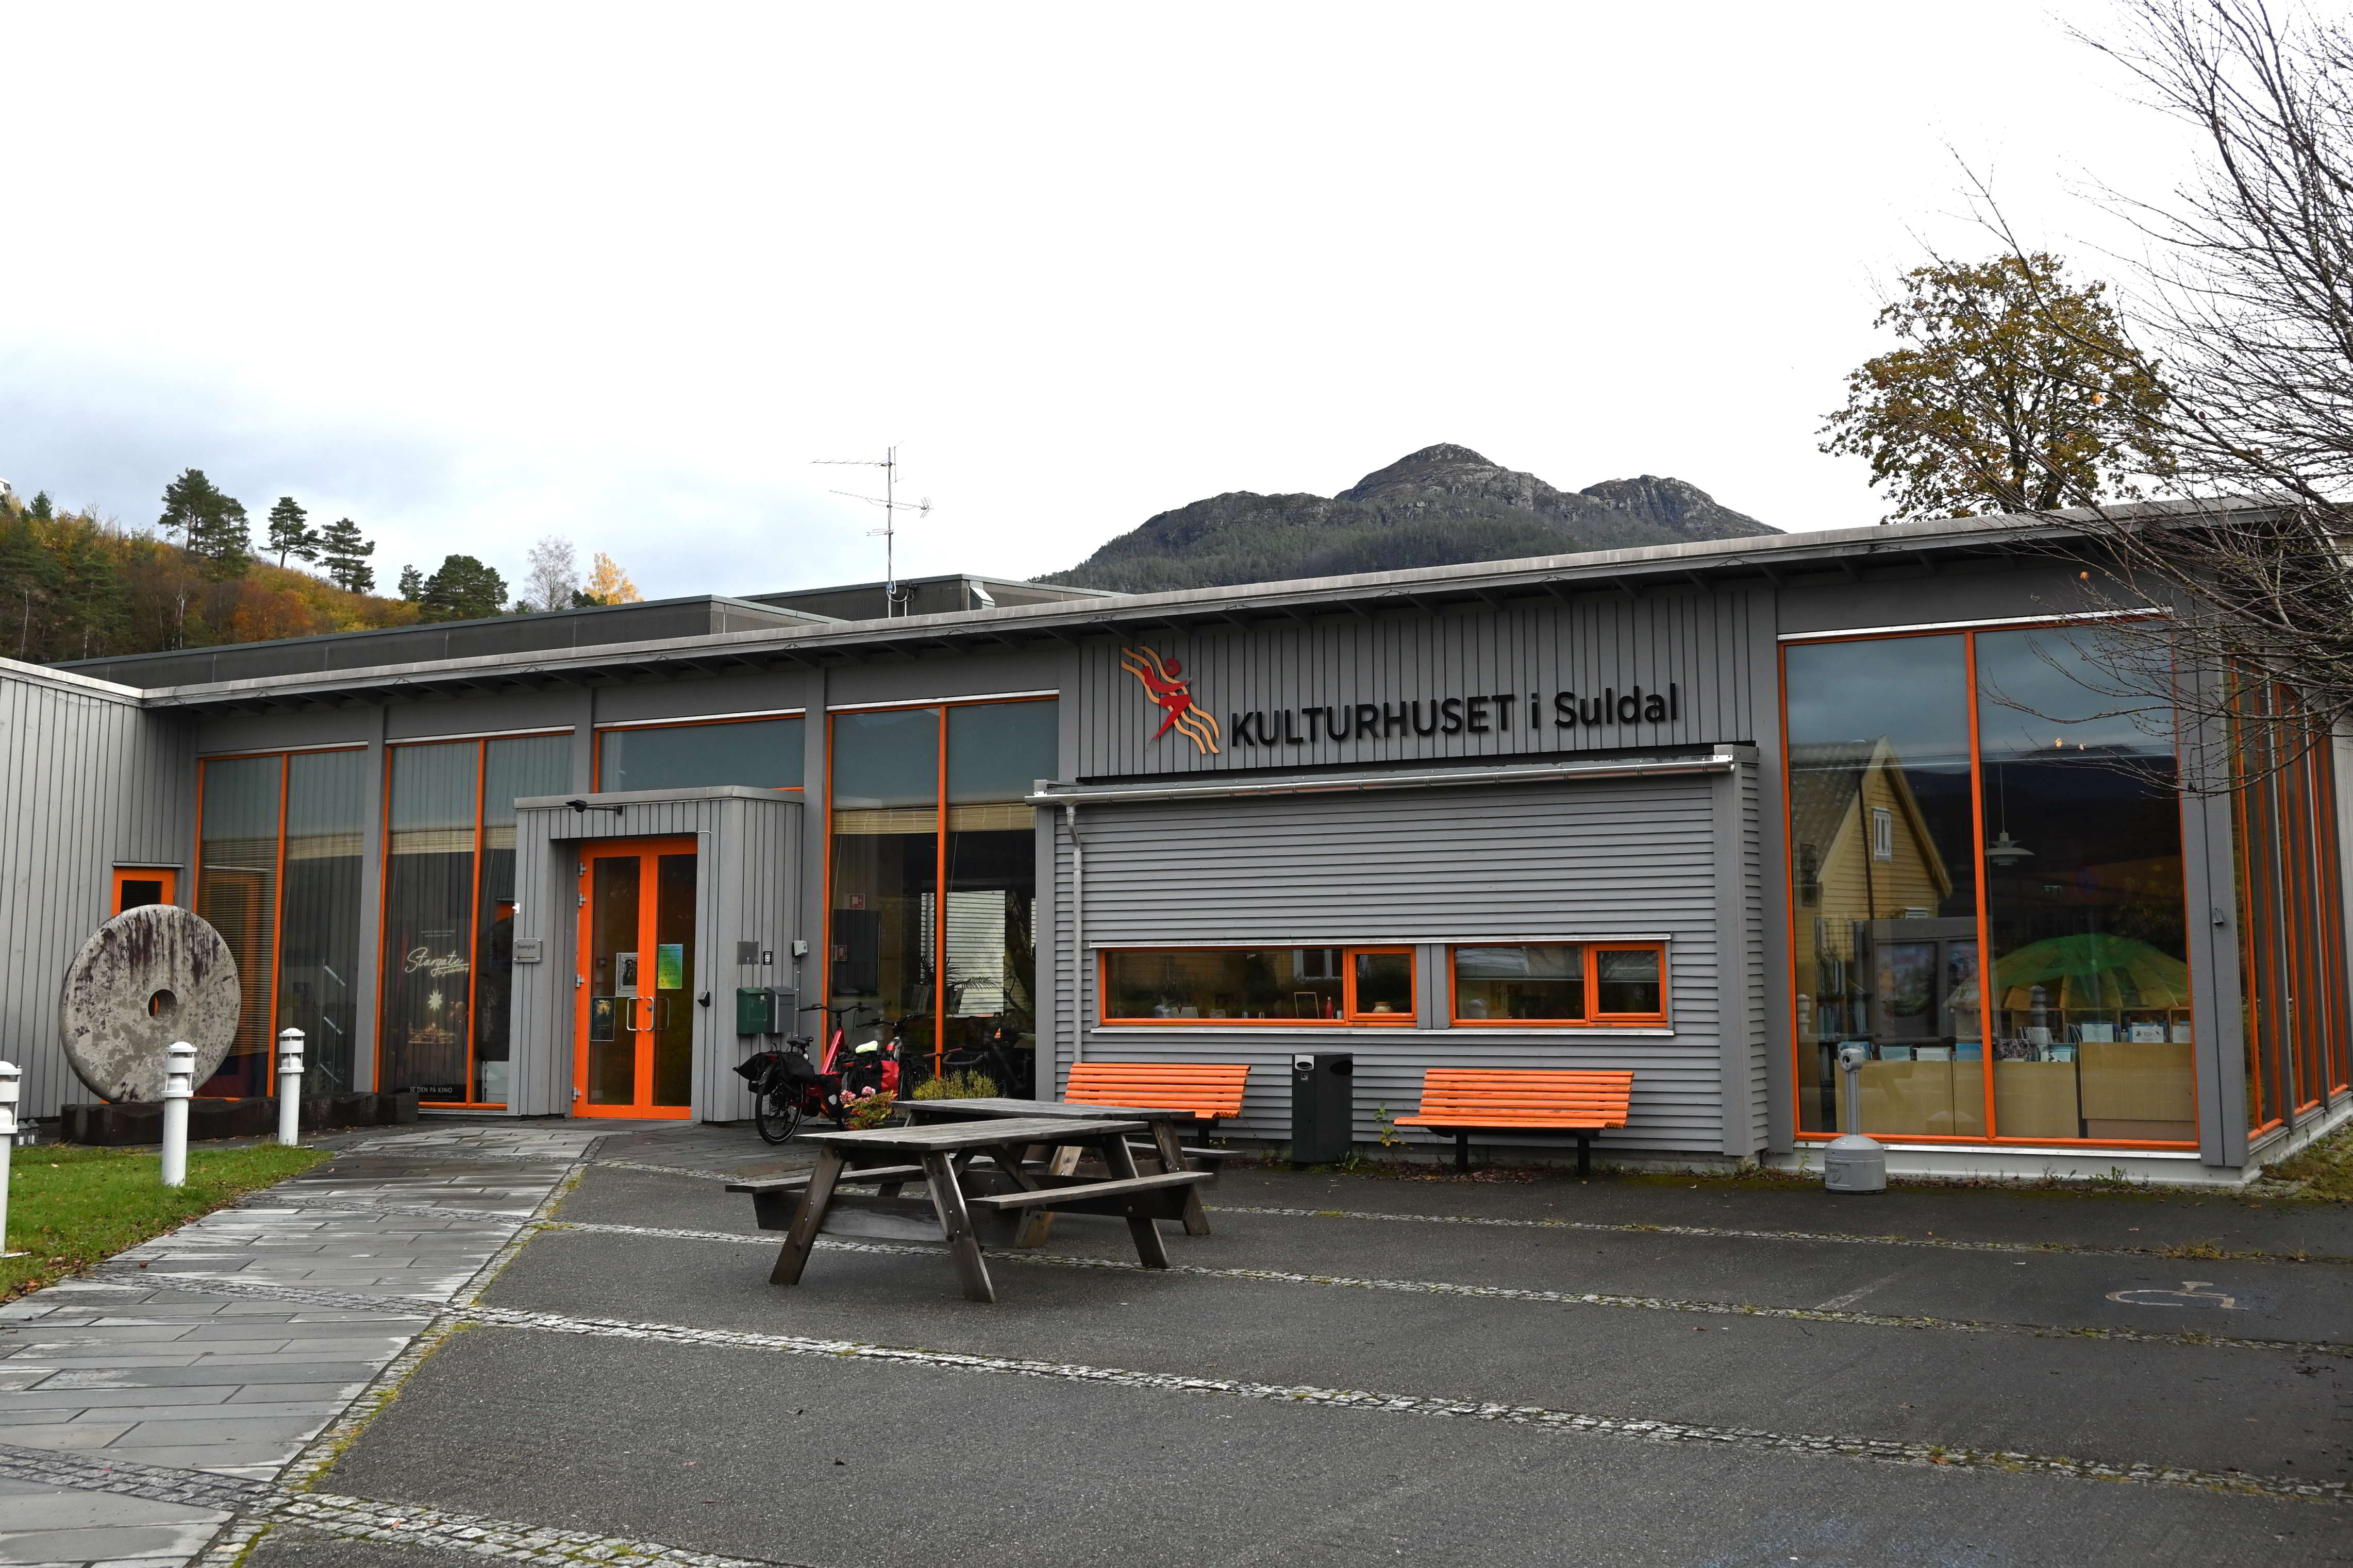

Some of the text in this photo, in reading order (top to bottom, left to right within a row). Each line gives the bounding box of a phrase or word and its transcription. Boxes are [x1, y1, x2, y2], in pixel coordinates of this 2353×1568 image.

[1231, 683, 1678, 747] KULTURHUSET i Suldal
[405, 947, 470, 977] Stargate
